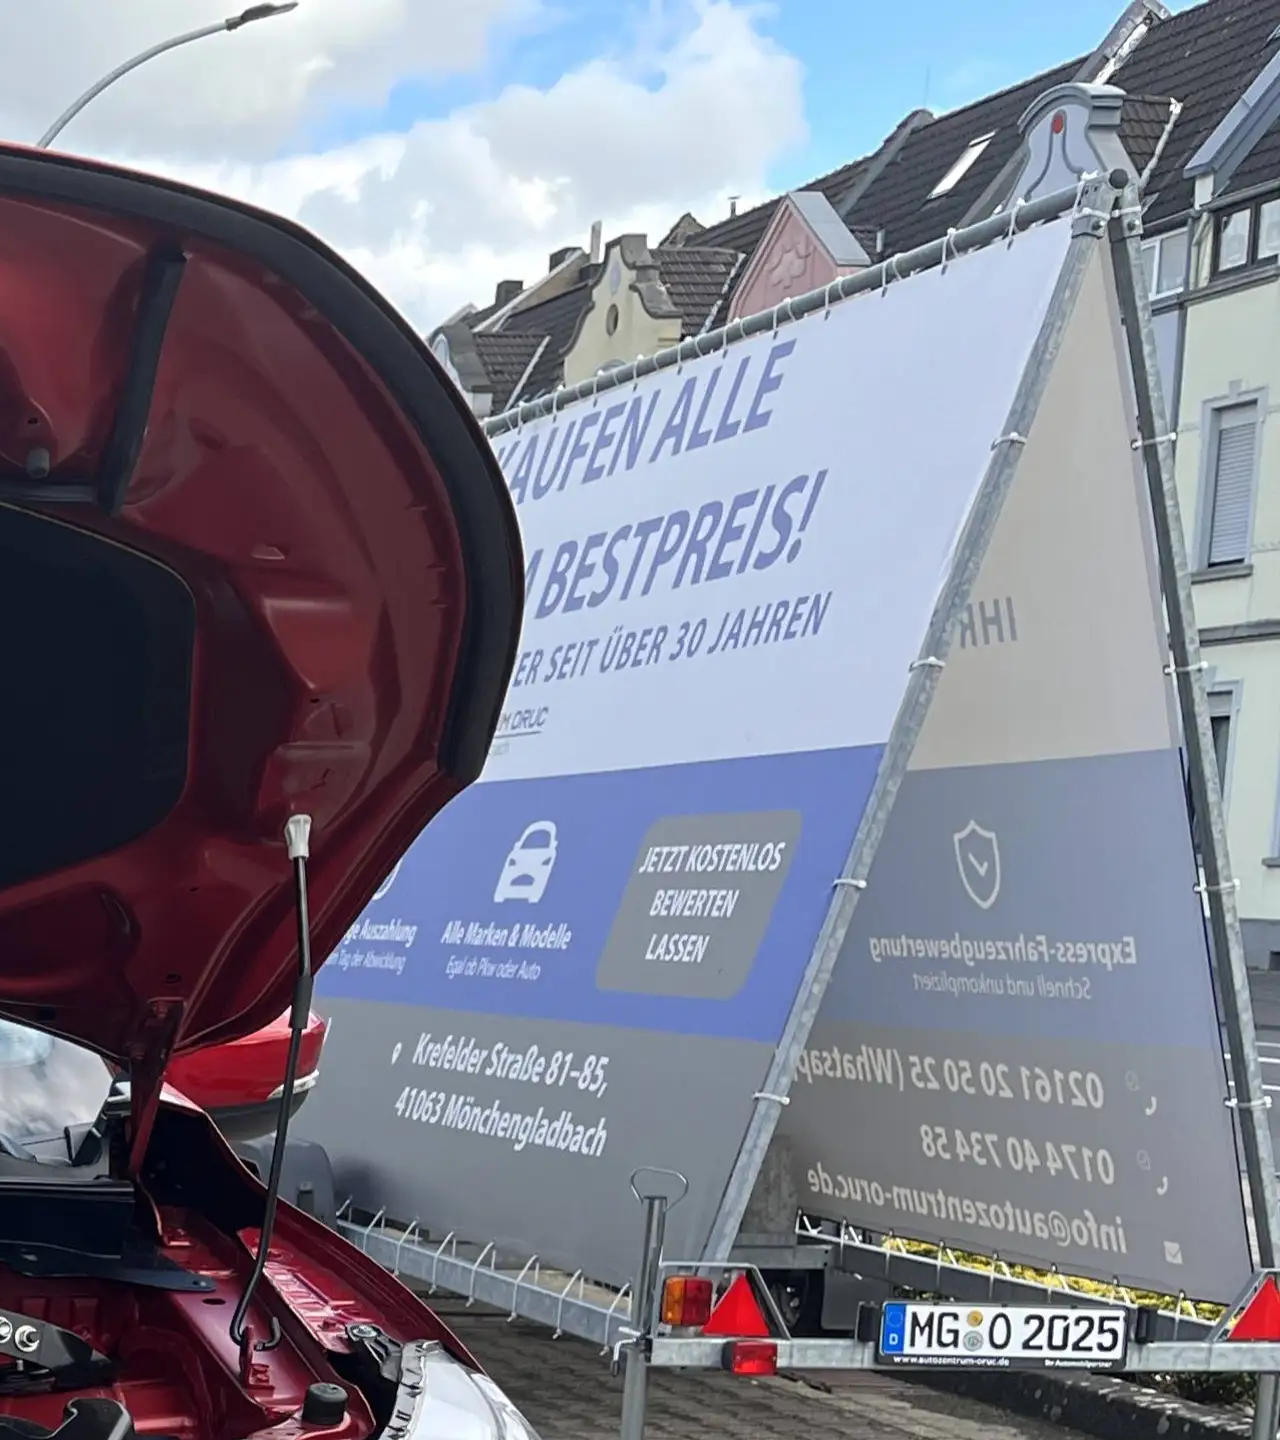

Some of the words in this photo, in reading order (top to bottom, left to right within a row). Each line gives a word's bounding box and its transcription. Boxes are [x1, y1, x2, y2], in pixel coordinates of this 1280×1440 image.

[648, 339, 798, 464] ALLE
[535, 469, 829, 619] BESTPREIS!
[544, 638, 600, 682] SEIT
[599, 625, 669, 673] ÜBER
[669, 617, 708, 661] 30
[707, 591, 833, 654] JAHREN
[639, 845, 691, 873] JETZT
[684, 842, 786, 872] KOSTENLOS
[649, 889, 740, 918] BEWERTEN
[359, 918, 418, 948] Auszahlung
[441, 920, 465, 944] Alle
[464, 921, 509, 947] Marken
[507, 923, 521, 948] &
[519, 923, 572, 950] Modelle
[645, 934, 710, 963] LASSEN
[411, 1032, 489, 1075] Krefelder
[484, 1042, 546, 1083] Straße
[394, 1086, 446, 1124] 41063
[440, 1093, 608, 1157] Mönchengladbach
[909, 1311, 960, 1348] MG
[1022, 1313, 1121, 1353] 2025
[893, 1355, 1010, 1367] www.autozentrum-oruc.de
